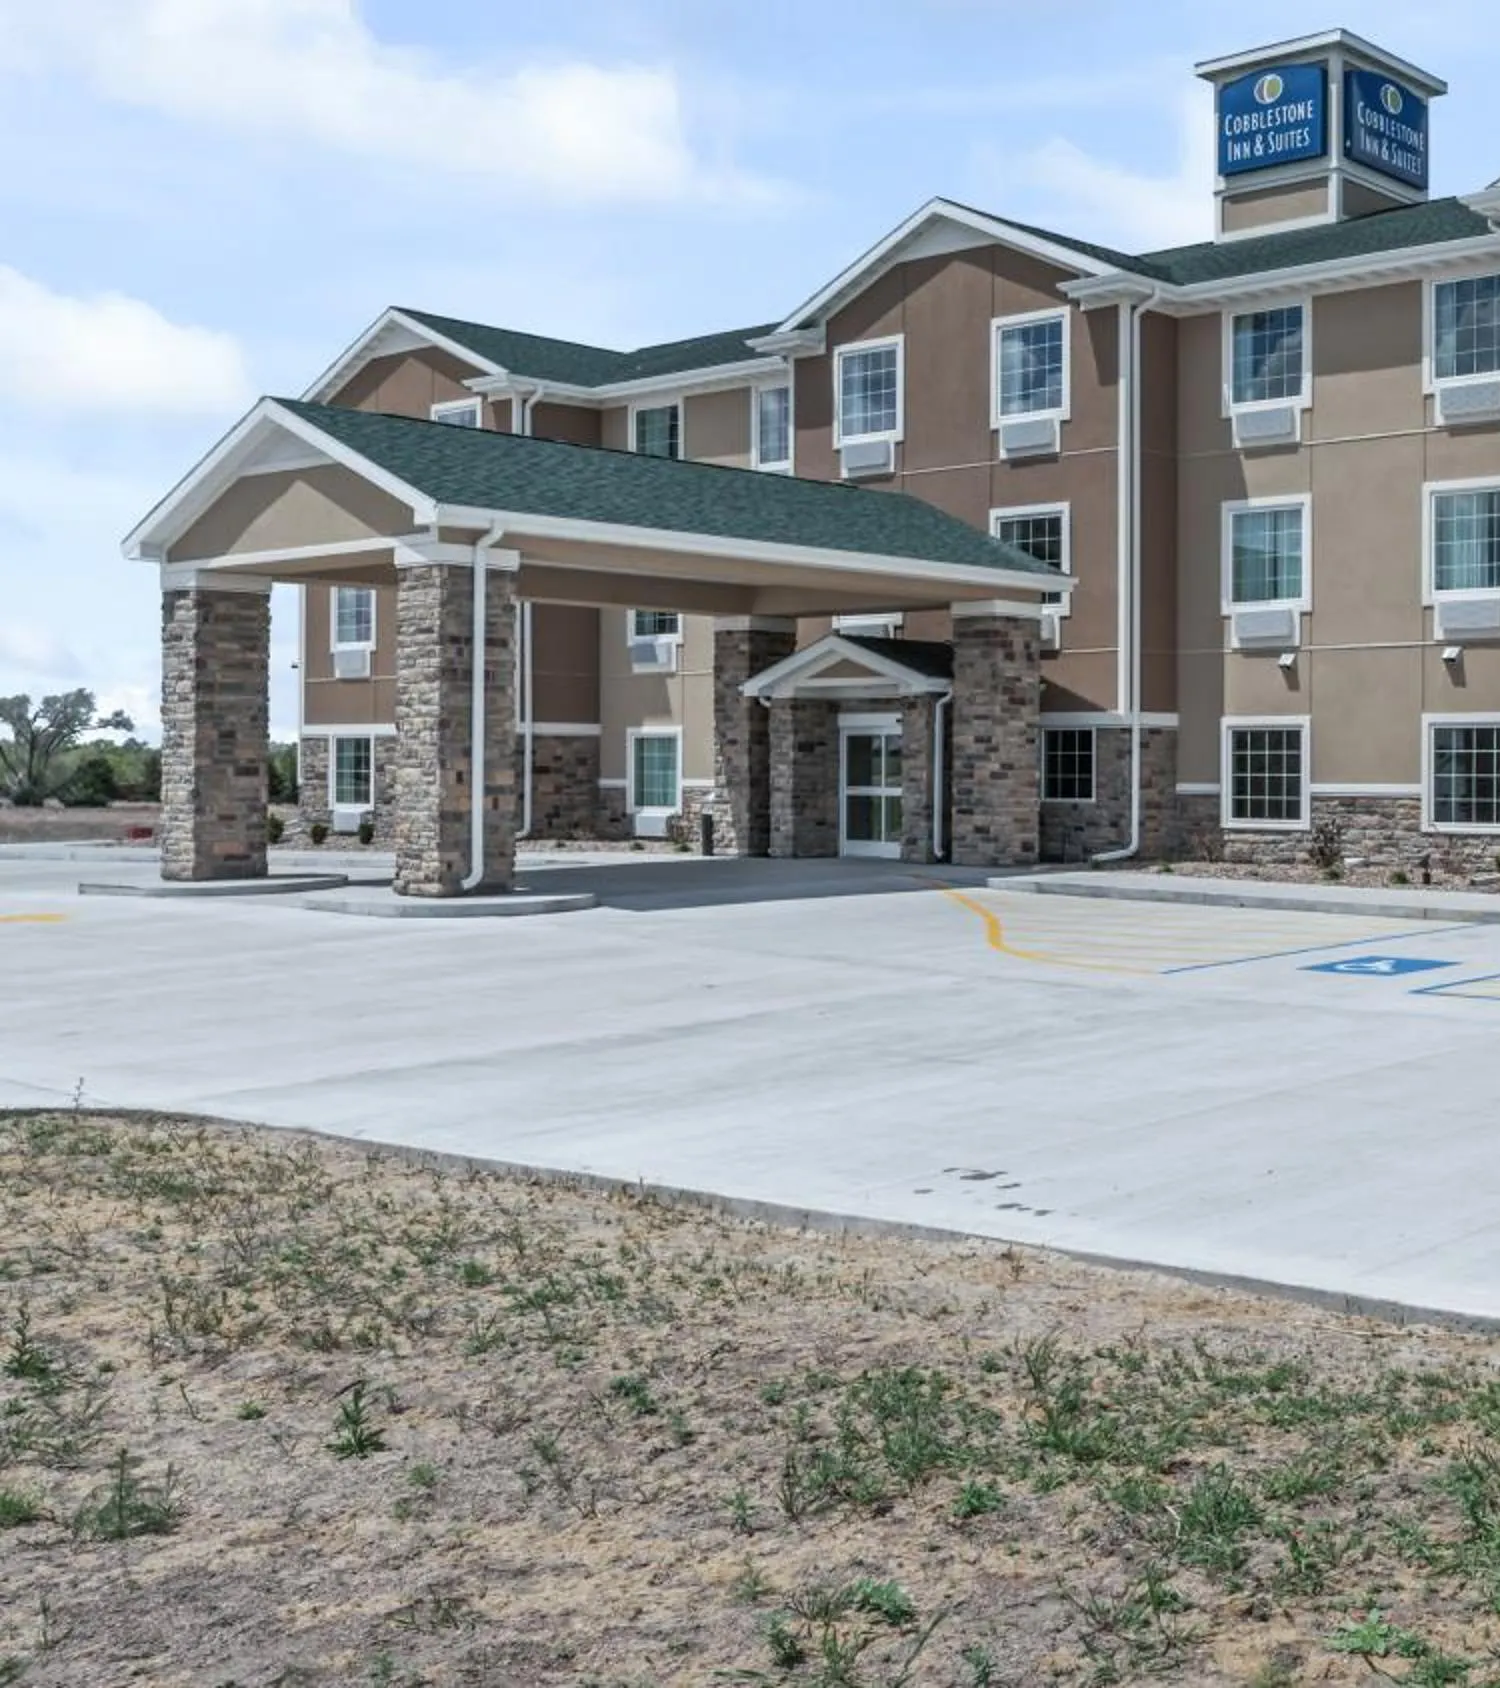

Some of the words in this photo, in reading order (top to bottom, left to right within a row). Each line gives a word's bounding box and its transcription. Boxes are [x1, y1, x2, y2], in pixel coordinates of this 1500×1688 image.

[1225, 100, 1313, 136] COBBLESTONE
[1357, 101, 1425, 150] COBBLESTONE
[1228, 141, 1250, 162] INN
[1254, 136, 1264, 155] &
[1268, 128, 1311, 153] SUITES
[1360, 128, 1379, 156] INN
[1381, 141, 1389, 161] &
